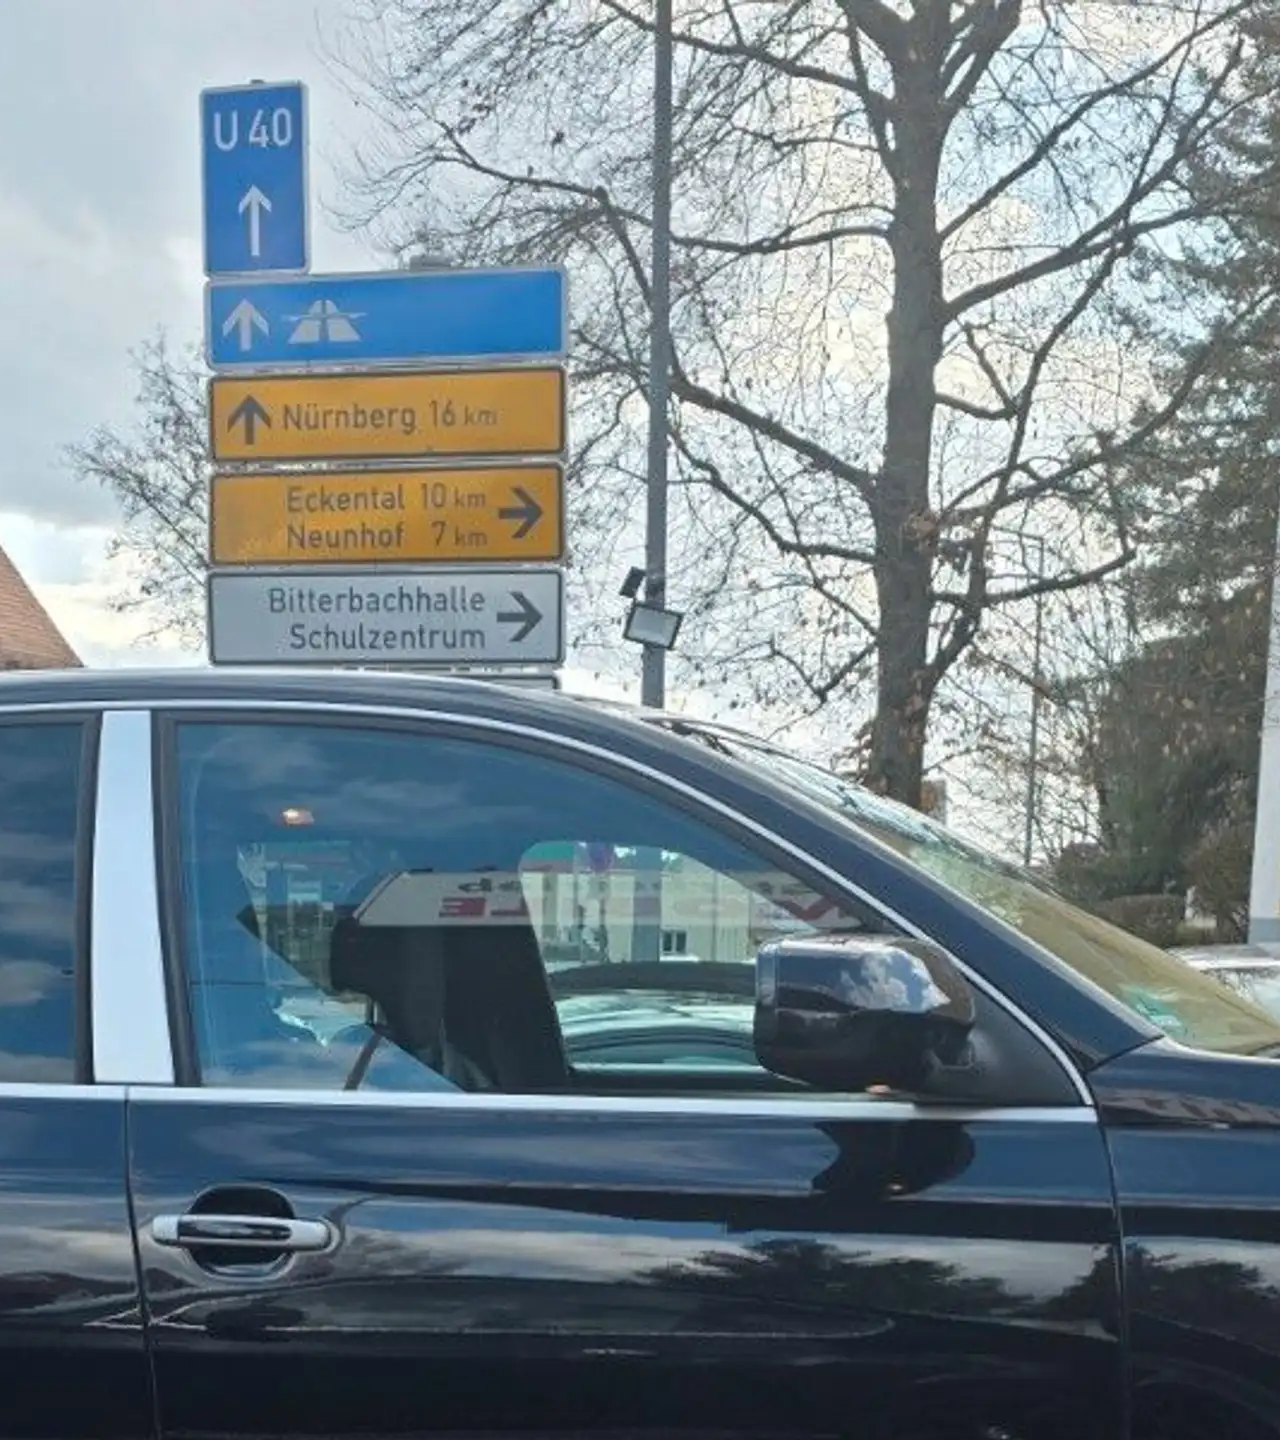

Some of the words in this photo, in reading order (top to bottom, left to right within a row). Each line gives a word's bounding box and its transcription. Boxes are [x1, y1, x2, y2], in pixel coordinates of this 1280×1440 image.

[213, 109, 238, 151] U
[248, 107, 292, 148] 40
[283, 403, 416, 435] Nürnberg
[430, 400, 456, 428] 16
[464, 402, 498, 426] km
[287, 483, 406, 513] Eckental
[421, 482, 448, 509] 10
[455, 484, 487, 509] km
[287, 521, 405, 549] Neunhof
[431, 520, 448, 547] 7
[455, 522, 487, 547] km
[269, 586, 486, 614] Bitterbachhalle
[290, 623, 486, 650] Schulzentrum
